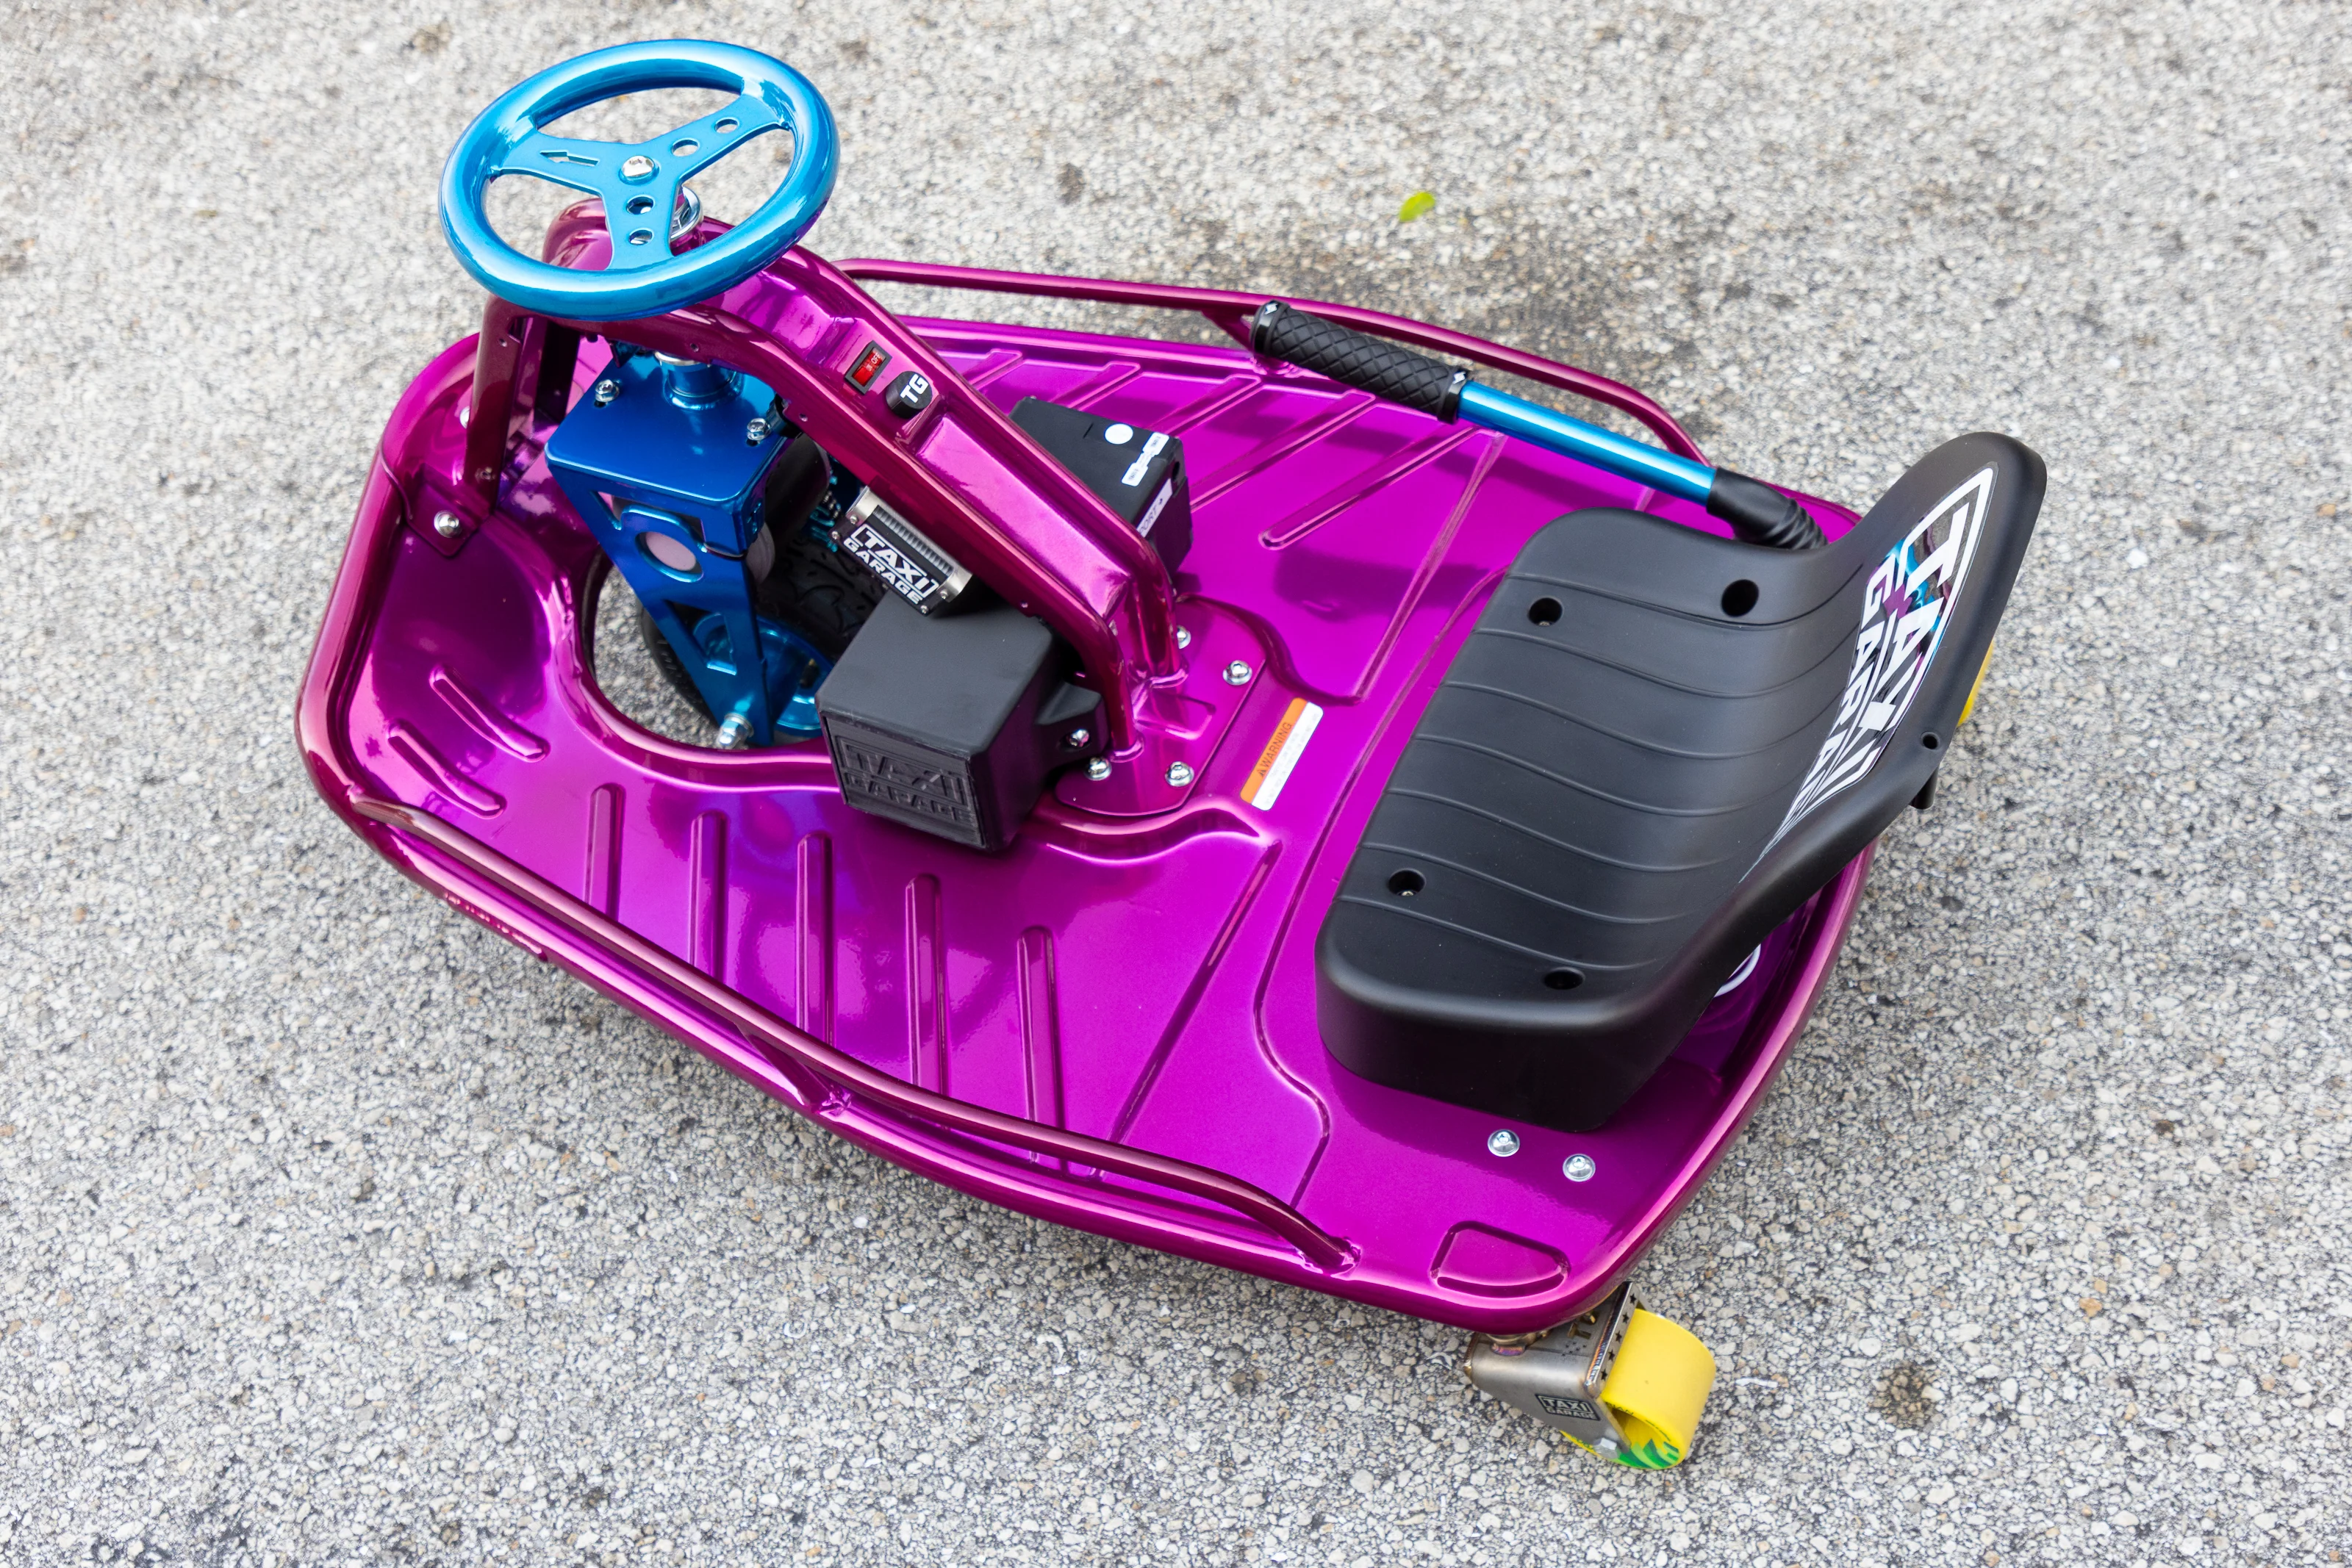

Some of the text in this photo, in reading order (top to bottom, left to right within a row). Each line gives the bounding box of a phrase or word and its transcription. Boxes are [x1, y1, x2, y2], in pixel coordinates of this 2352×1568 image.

[900, 373, 929, 403] TG
[843, 537, 923, 605] GARAGE
[864, 530, 930, 590] TAXI
[1260, 722, 1292, 769] WARNING
[846, 744, 958, 801] TAXI
[1543, 1398, 1588, 1411] TAXI
[1546, 1407, 1598, 1420] GARAGE
